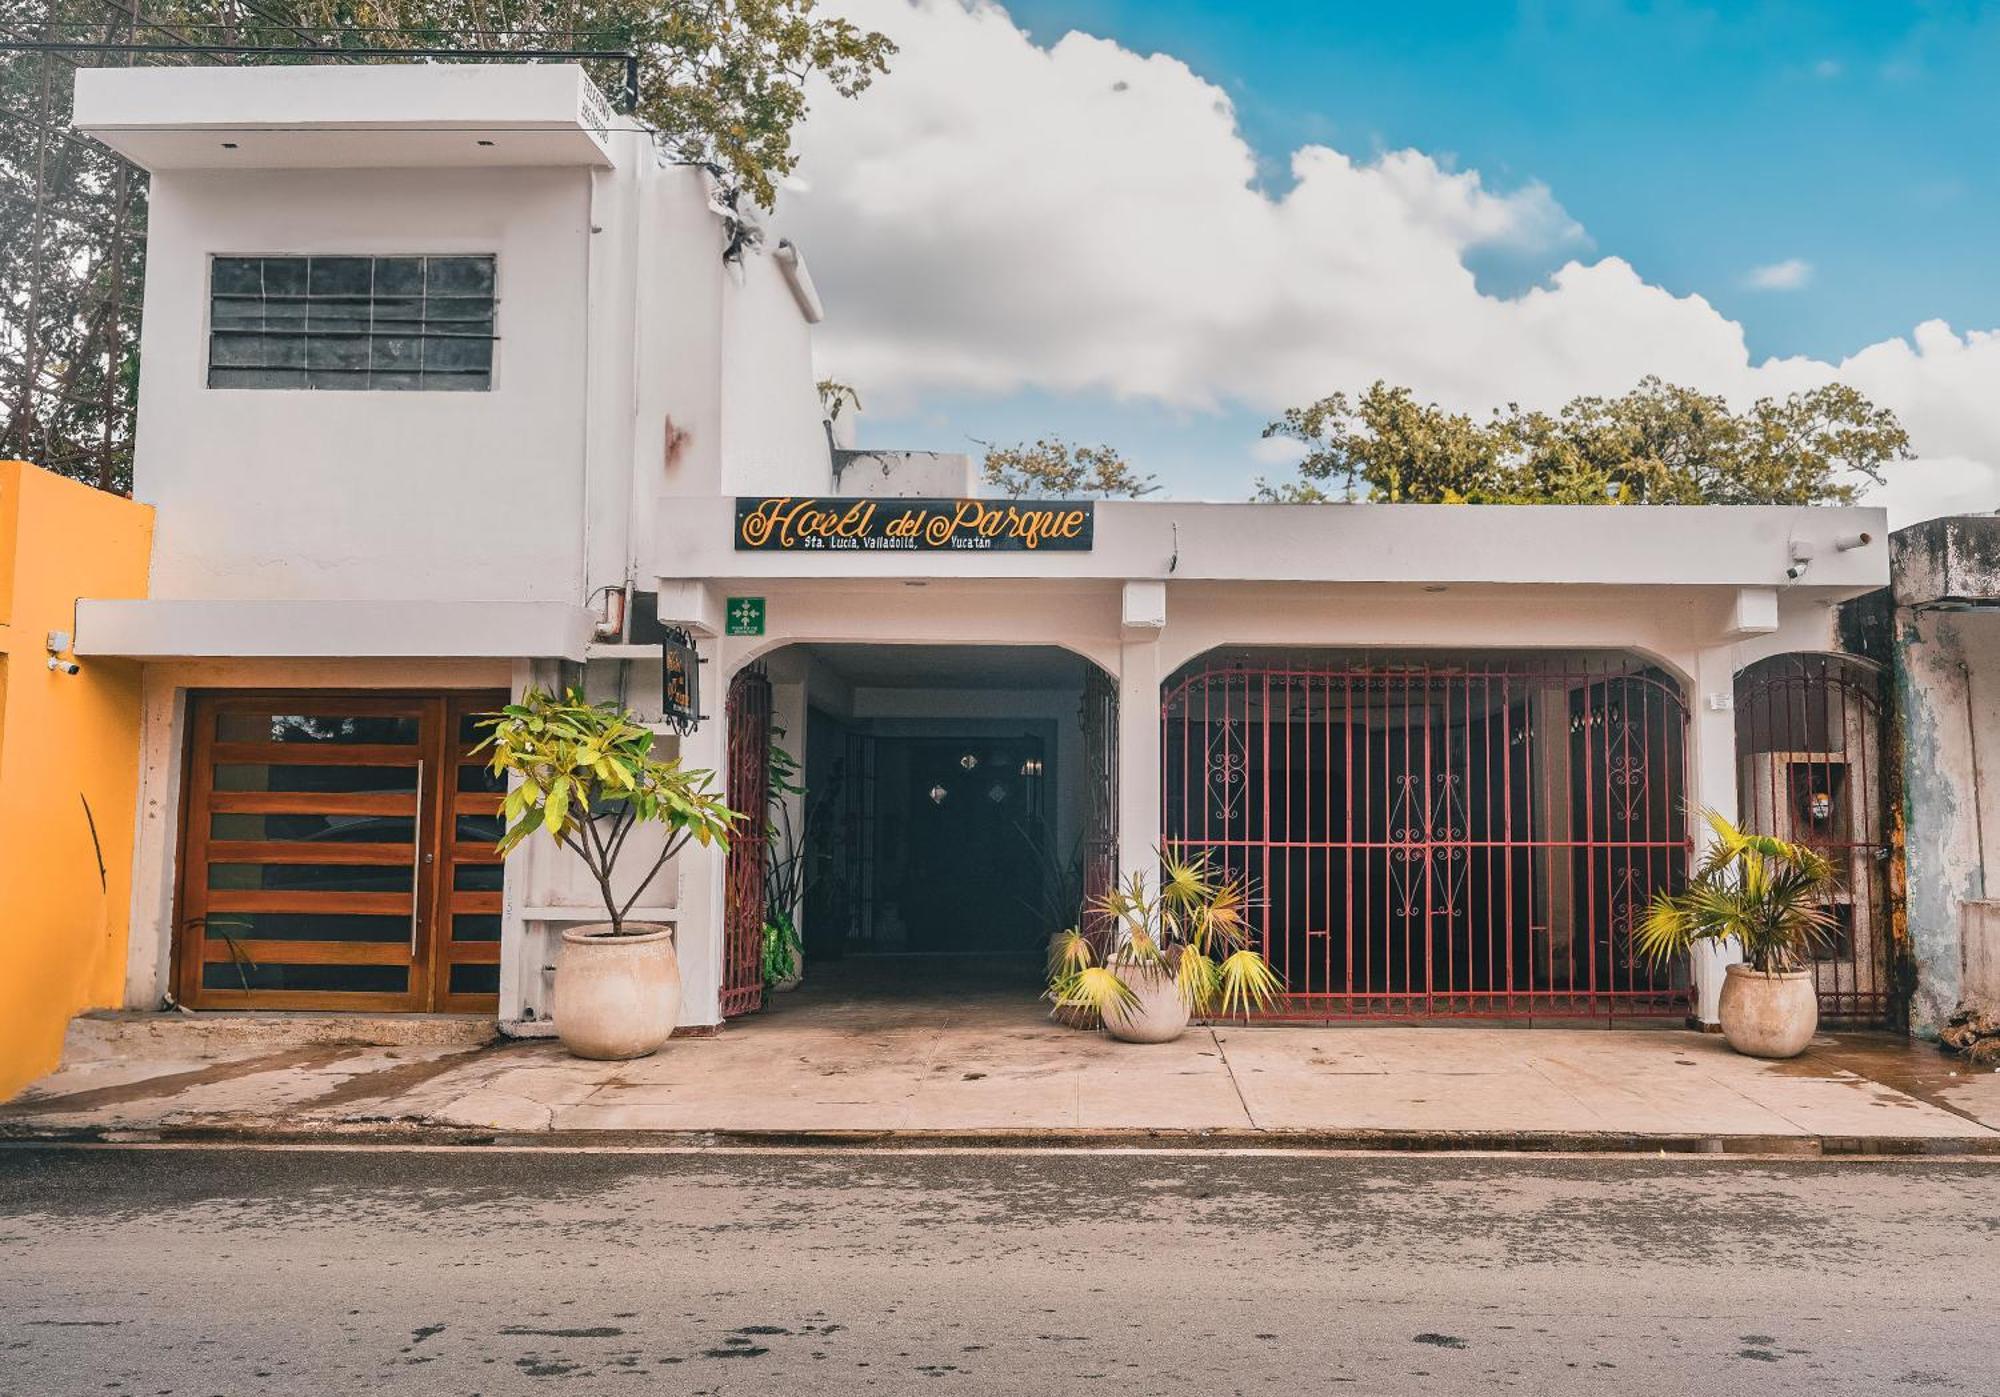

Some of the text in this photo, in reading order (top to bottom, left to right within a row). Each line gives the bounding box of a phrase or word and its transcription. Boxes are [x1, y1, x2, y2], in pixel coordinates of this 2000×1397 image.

[885, 510, 927, 537] del
[926, 500, 1084, 549] Parque
[804, 535, 825, 548] Sta.
[951, 535, 991, 549] Yucatán
